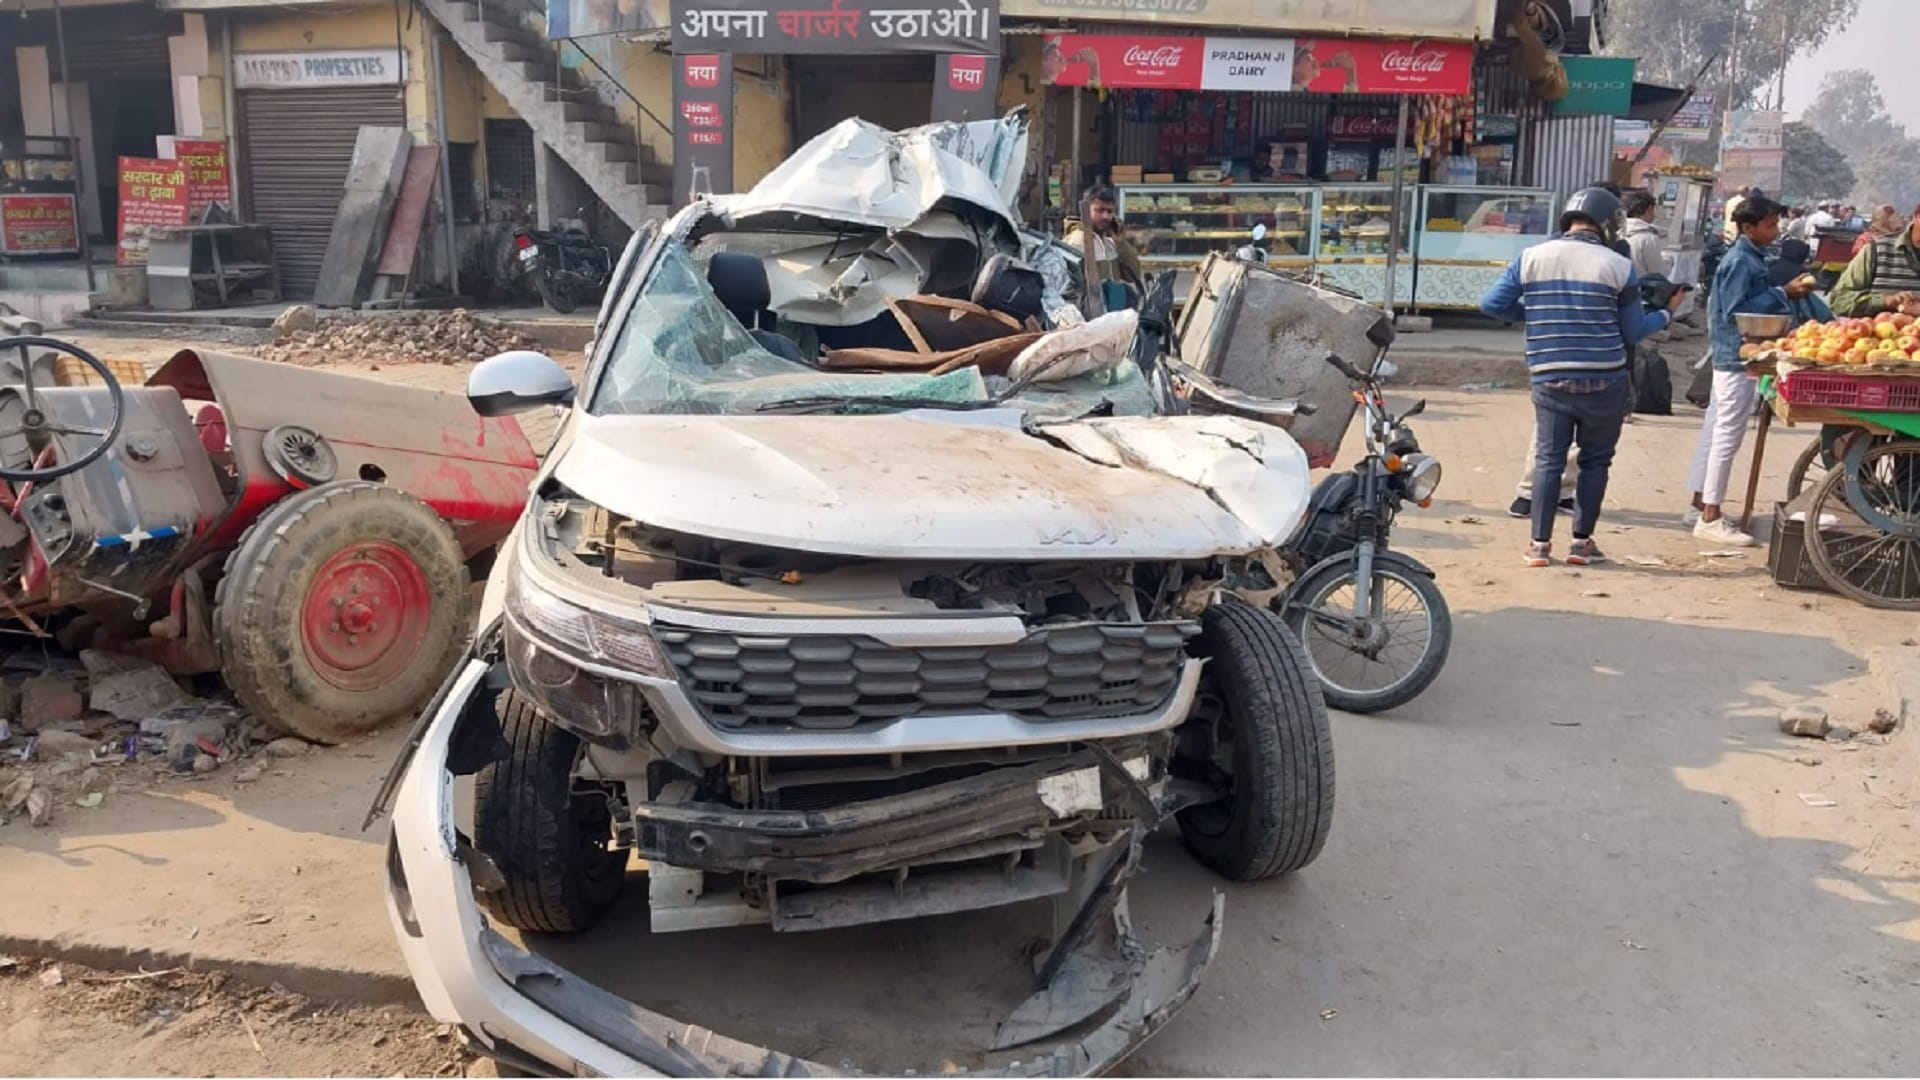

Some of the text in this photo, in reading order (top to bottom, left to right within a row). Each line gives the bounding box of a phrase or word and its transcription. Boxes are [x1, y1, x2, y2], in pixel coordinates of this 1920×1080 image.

[680, 9, 768, 38] अपना
[776, 0, 861, 38] चार्जर
[1212, 51, 1285, 62] PRADHAN JI
[304, 57, 385, 77] PROPERTIES
[688, 66, 717, 80] नया
[1229, 66, 1265, 76] DAIRY
[952, 68, 983, 84] नया
